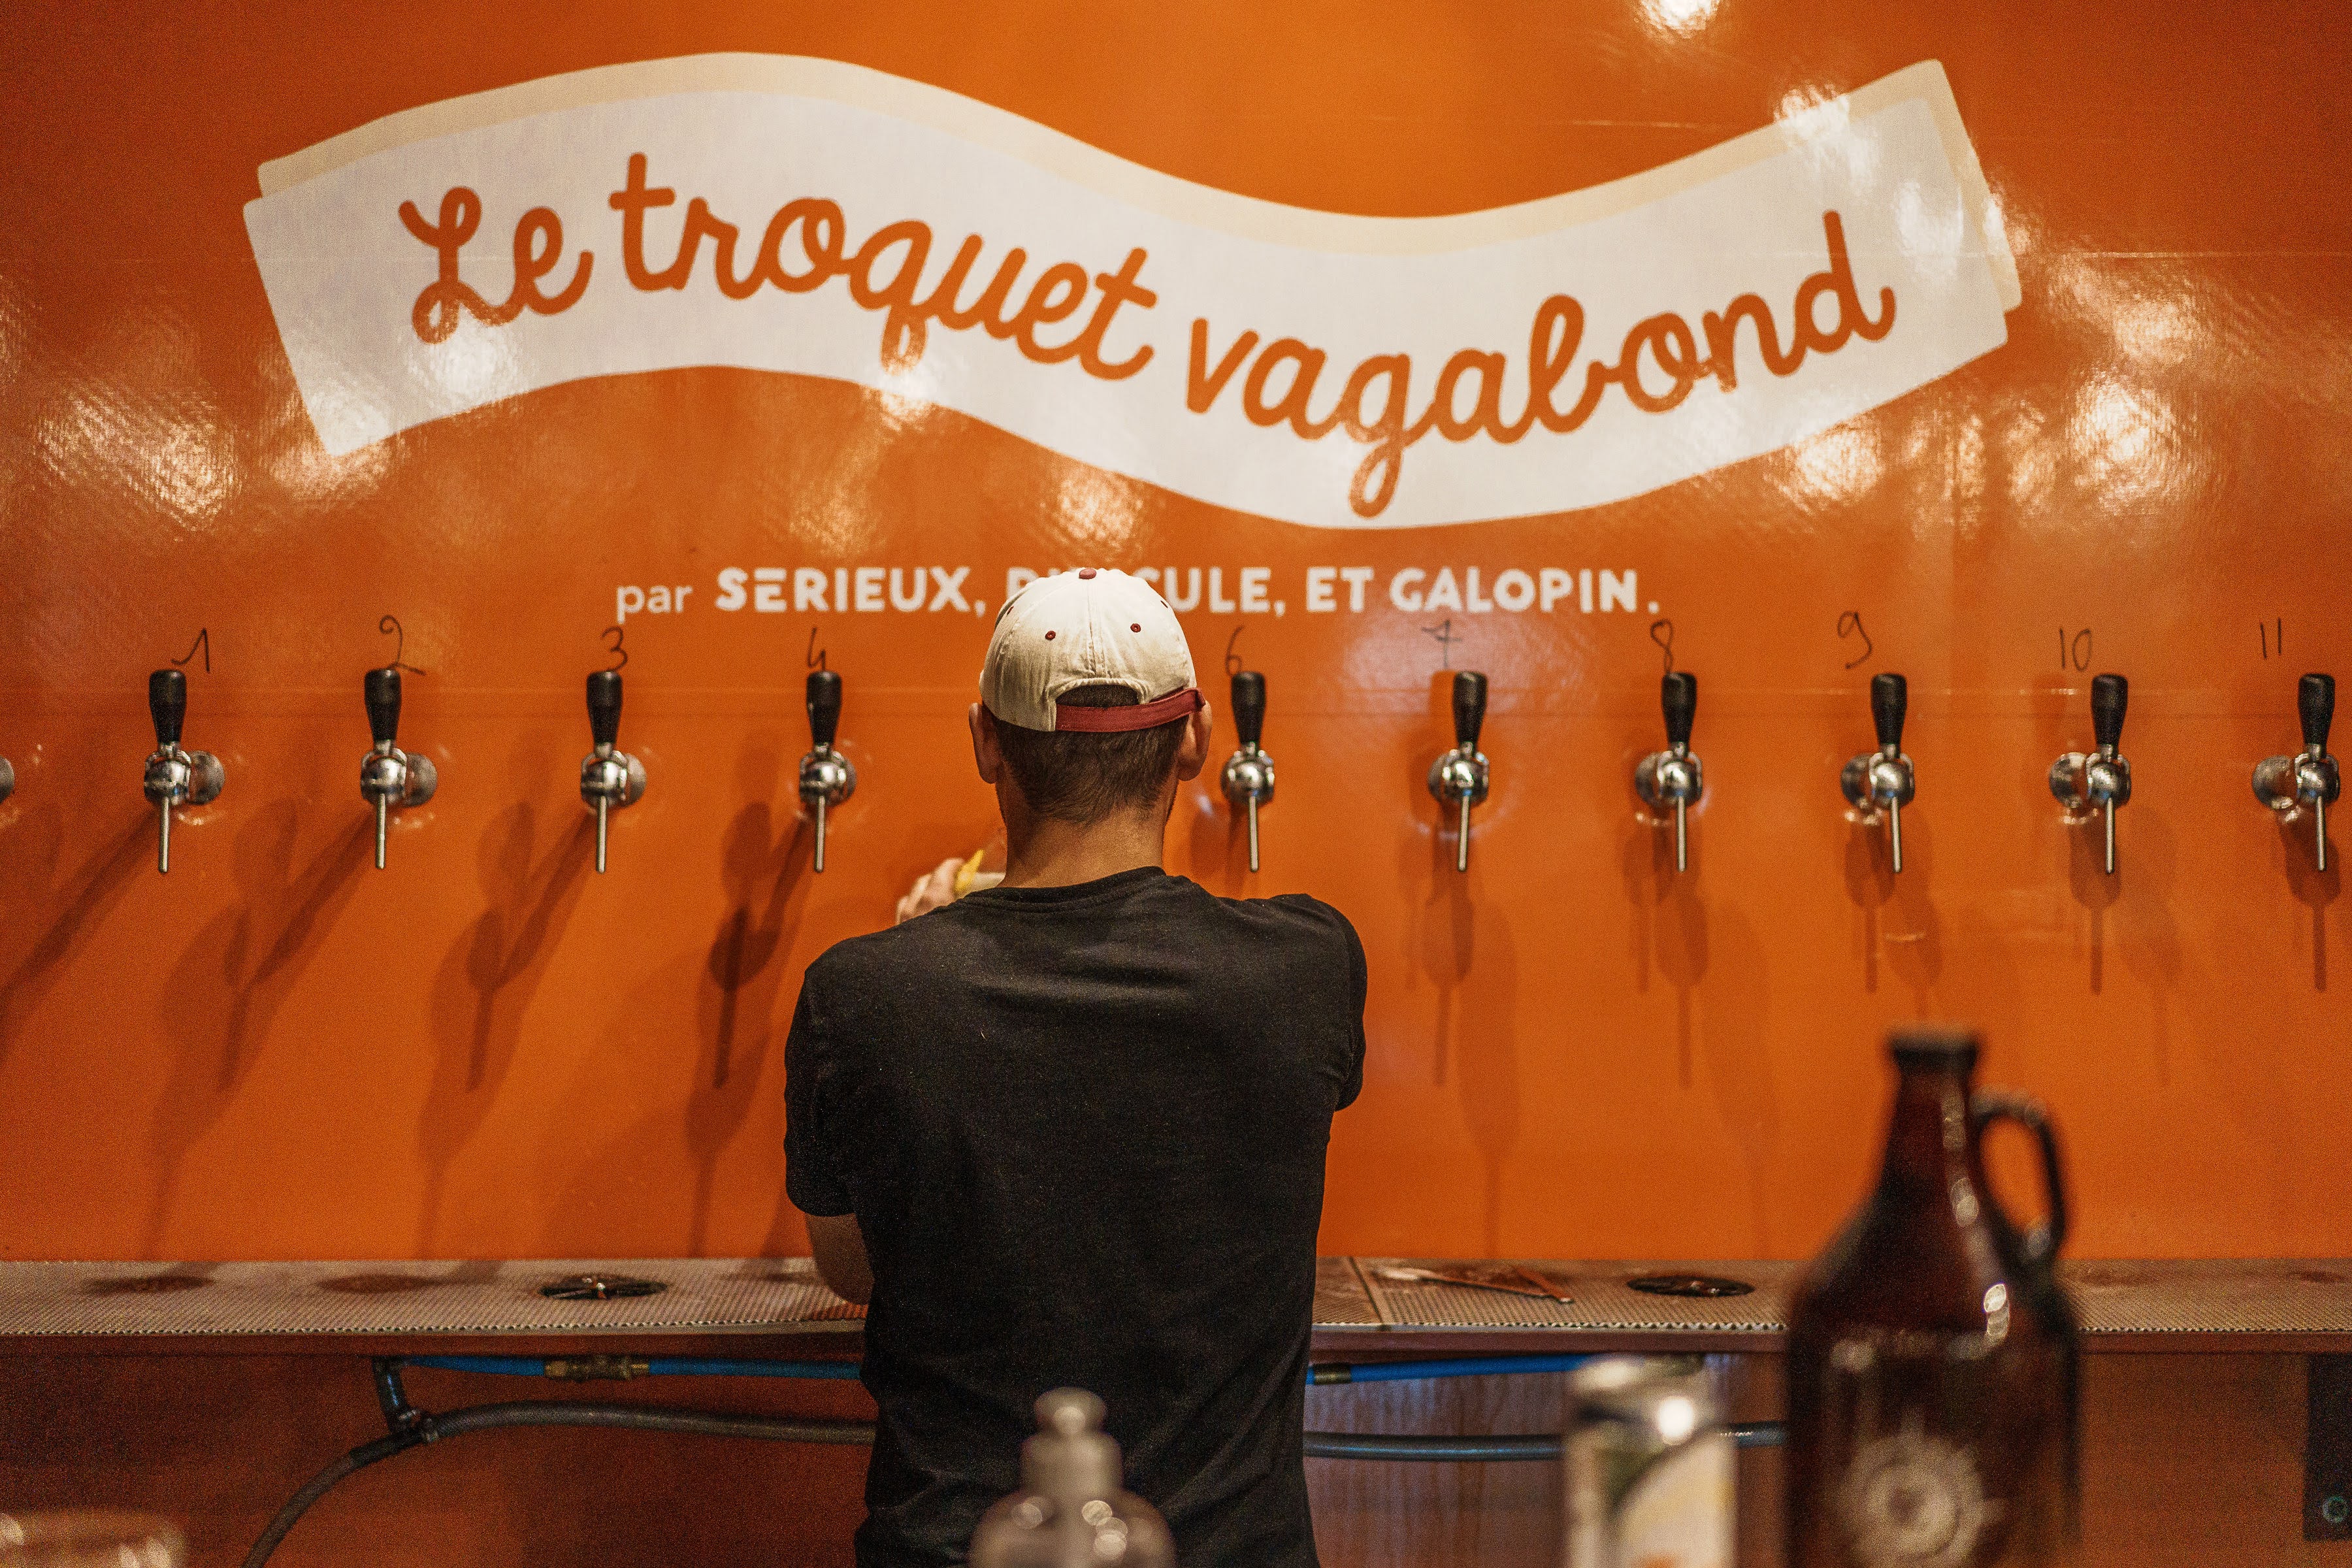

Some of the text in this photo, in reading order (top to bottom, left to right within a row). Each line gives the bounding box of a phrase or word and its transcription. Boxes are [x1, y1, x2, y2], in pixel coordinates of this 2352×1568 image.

[398, 152, 1897, 518] Le troquet vagabond
[616, 585, 693, 624] par
[1307, 566, 1374, 613] ET
[171, 627, 210, 672] 1
[600, 626, 629, 672] 3
[807, 627, 826, 672] 4
[1837, 611, 1872, 670] 9
[2059, 627, 2091, 672] 10
[2260, 617, 2281, 660] 11
